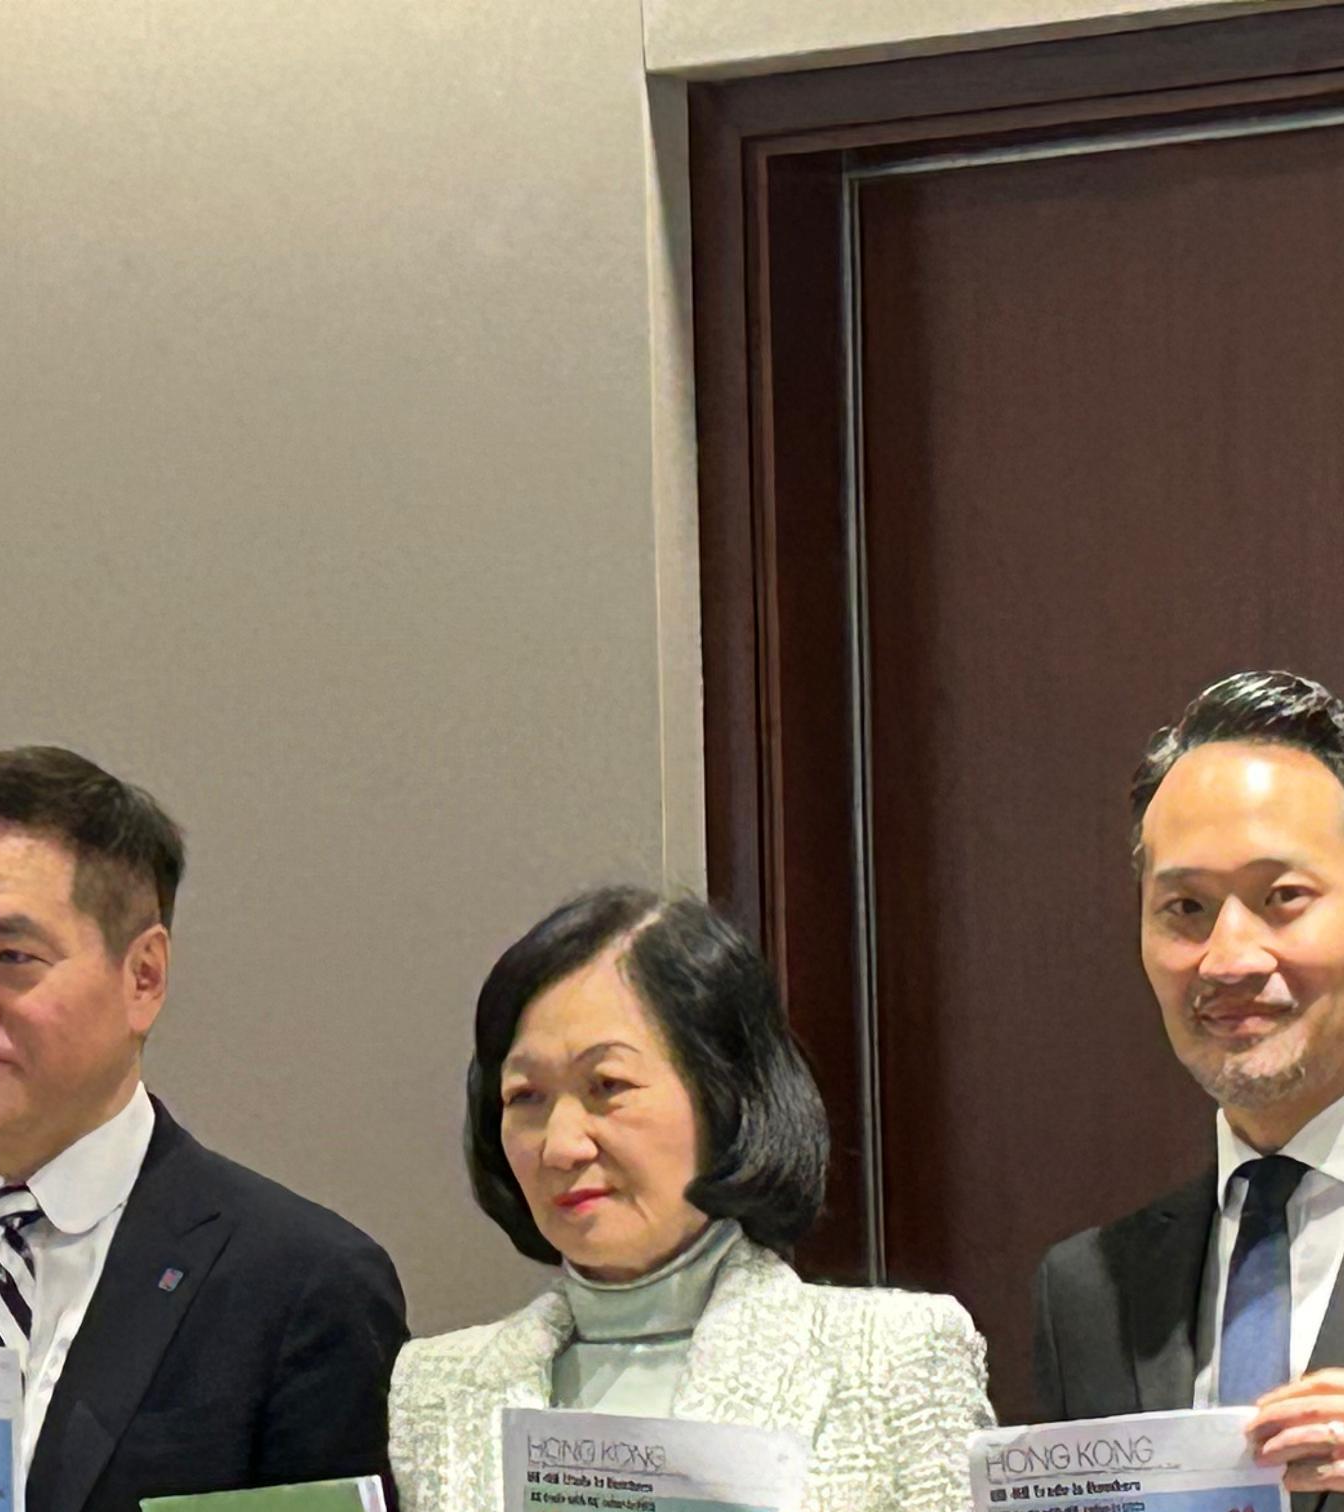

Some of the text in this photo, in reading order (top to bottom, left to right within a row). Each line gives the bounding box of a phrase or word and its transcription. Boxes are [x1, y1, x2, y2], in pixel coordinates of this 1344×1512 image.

[528, 1434, 667, 1472] HONG KONG
[986, 1436, 1153, 1475] HONG KONG
